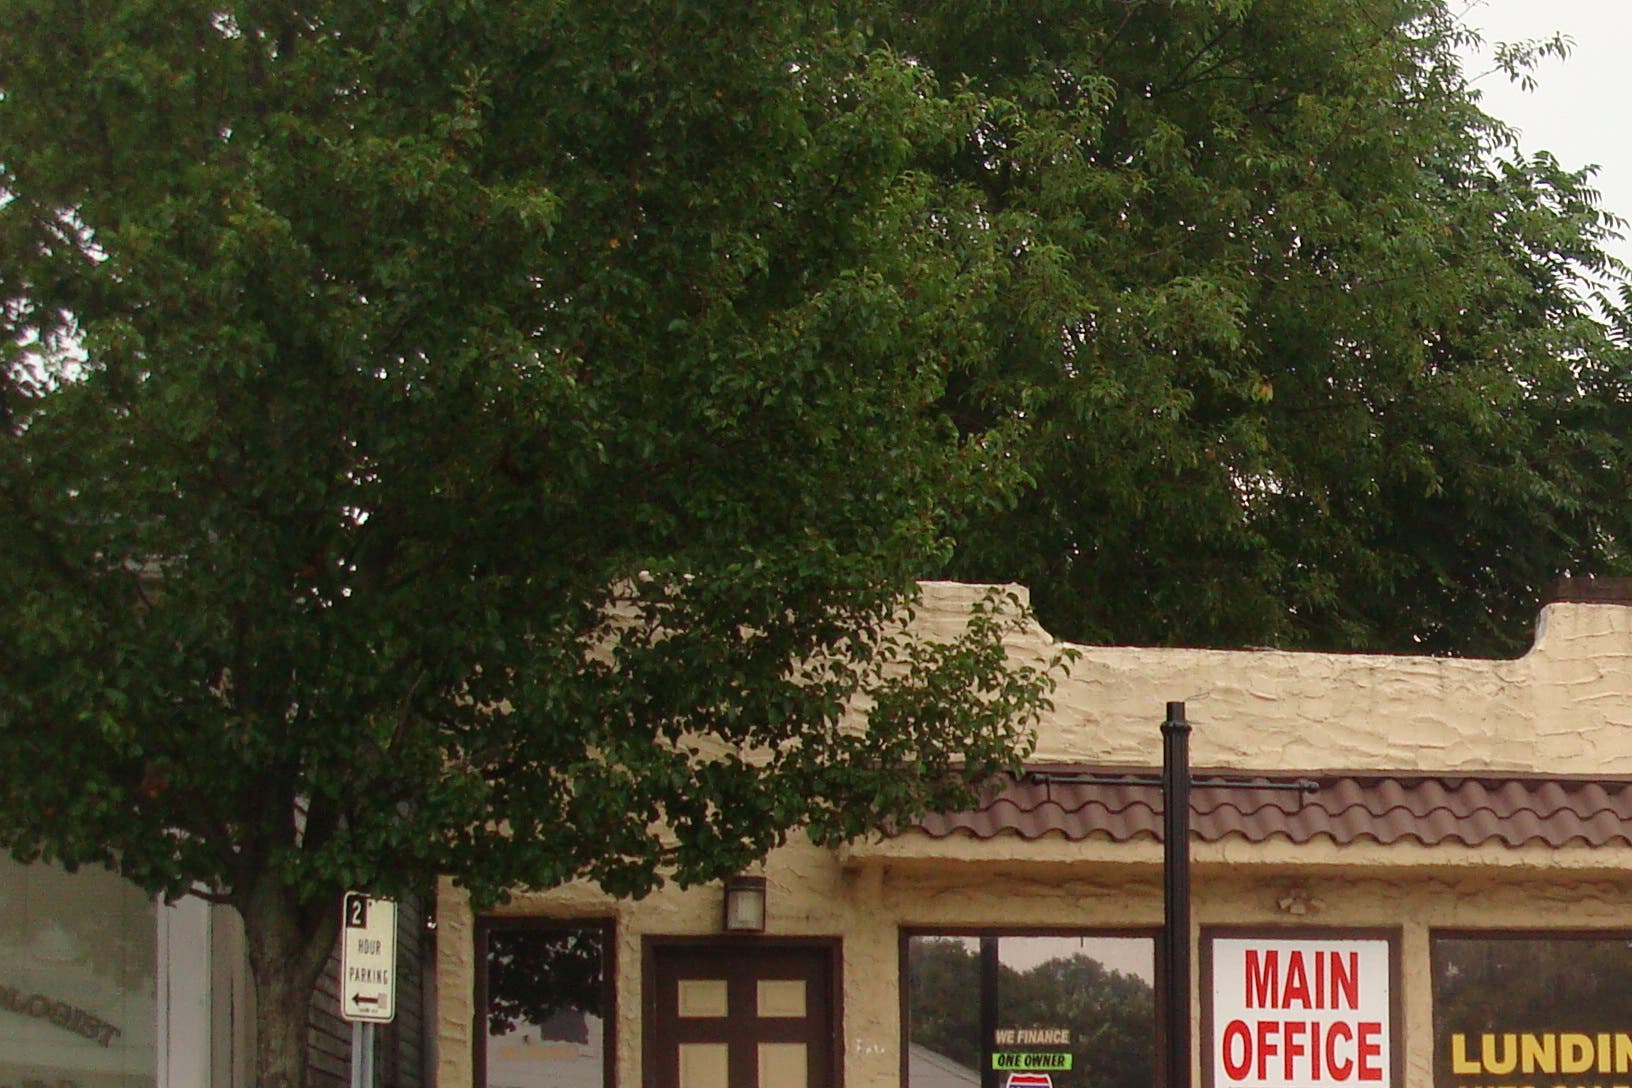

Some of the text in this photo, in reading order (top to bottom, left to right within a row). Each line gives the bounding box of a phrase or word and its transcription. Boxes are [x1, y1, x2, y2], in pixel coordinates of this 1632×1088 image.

[351, 901, 362, 925] 2
[358, 938, 381, 956] HOUR
[349, 967, 388, 986] PARKING
[1245, 949, 1359, 1010] MAIN
[995, 1029, 1070, 1044] WE FINANCE
[1222, 1019, 1383, 1081] OFFICE
[997, 1054, 1065, 1067] ONE OWNER
